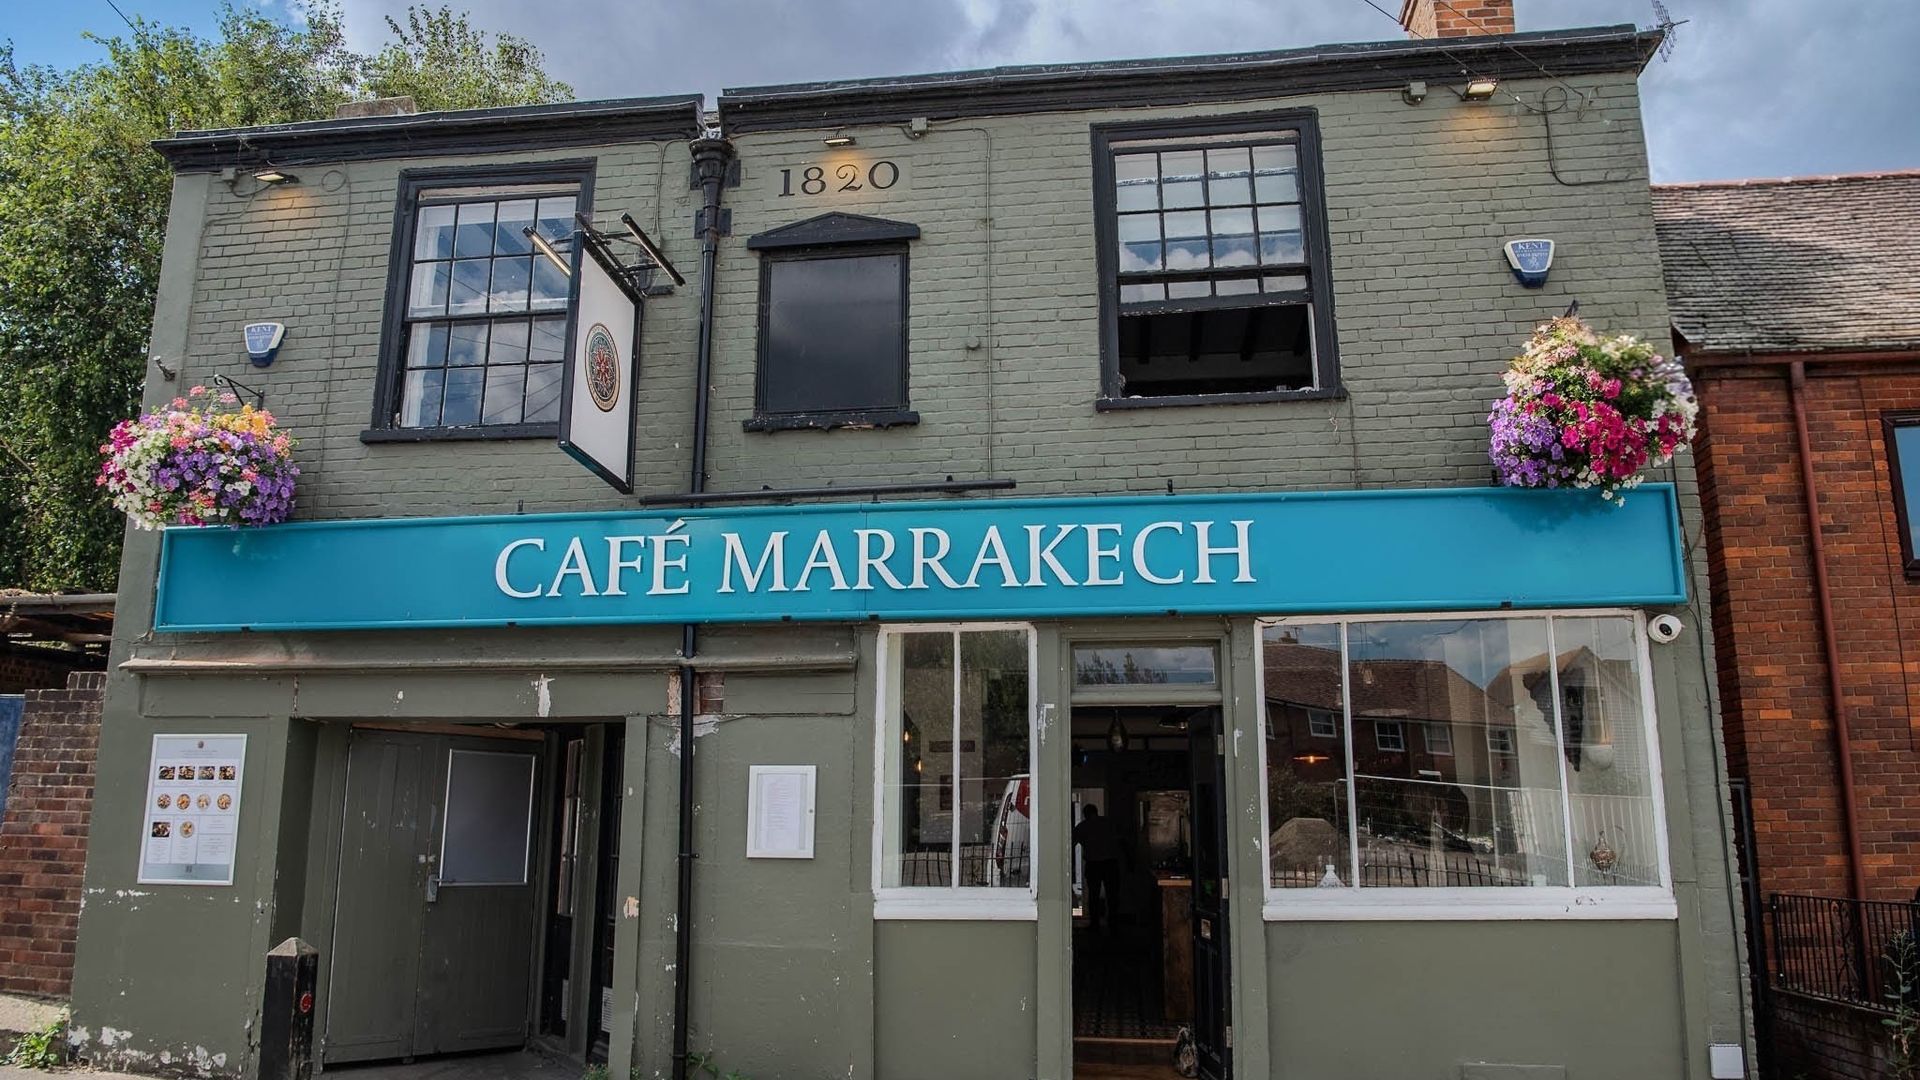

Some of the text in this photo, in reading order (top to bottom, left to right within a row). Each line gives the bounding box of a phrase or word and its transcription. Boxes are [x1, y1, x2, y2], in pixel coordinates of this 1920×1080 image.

[778, 161, 900, 197] 1820
[1518, 242, 1544, 250] KENT
[494, 518, 1258, 599] CAFÉ MARRAKECH
